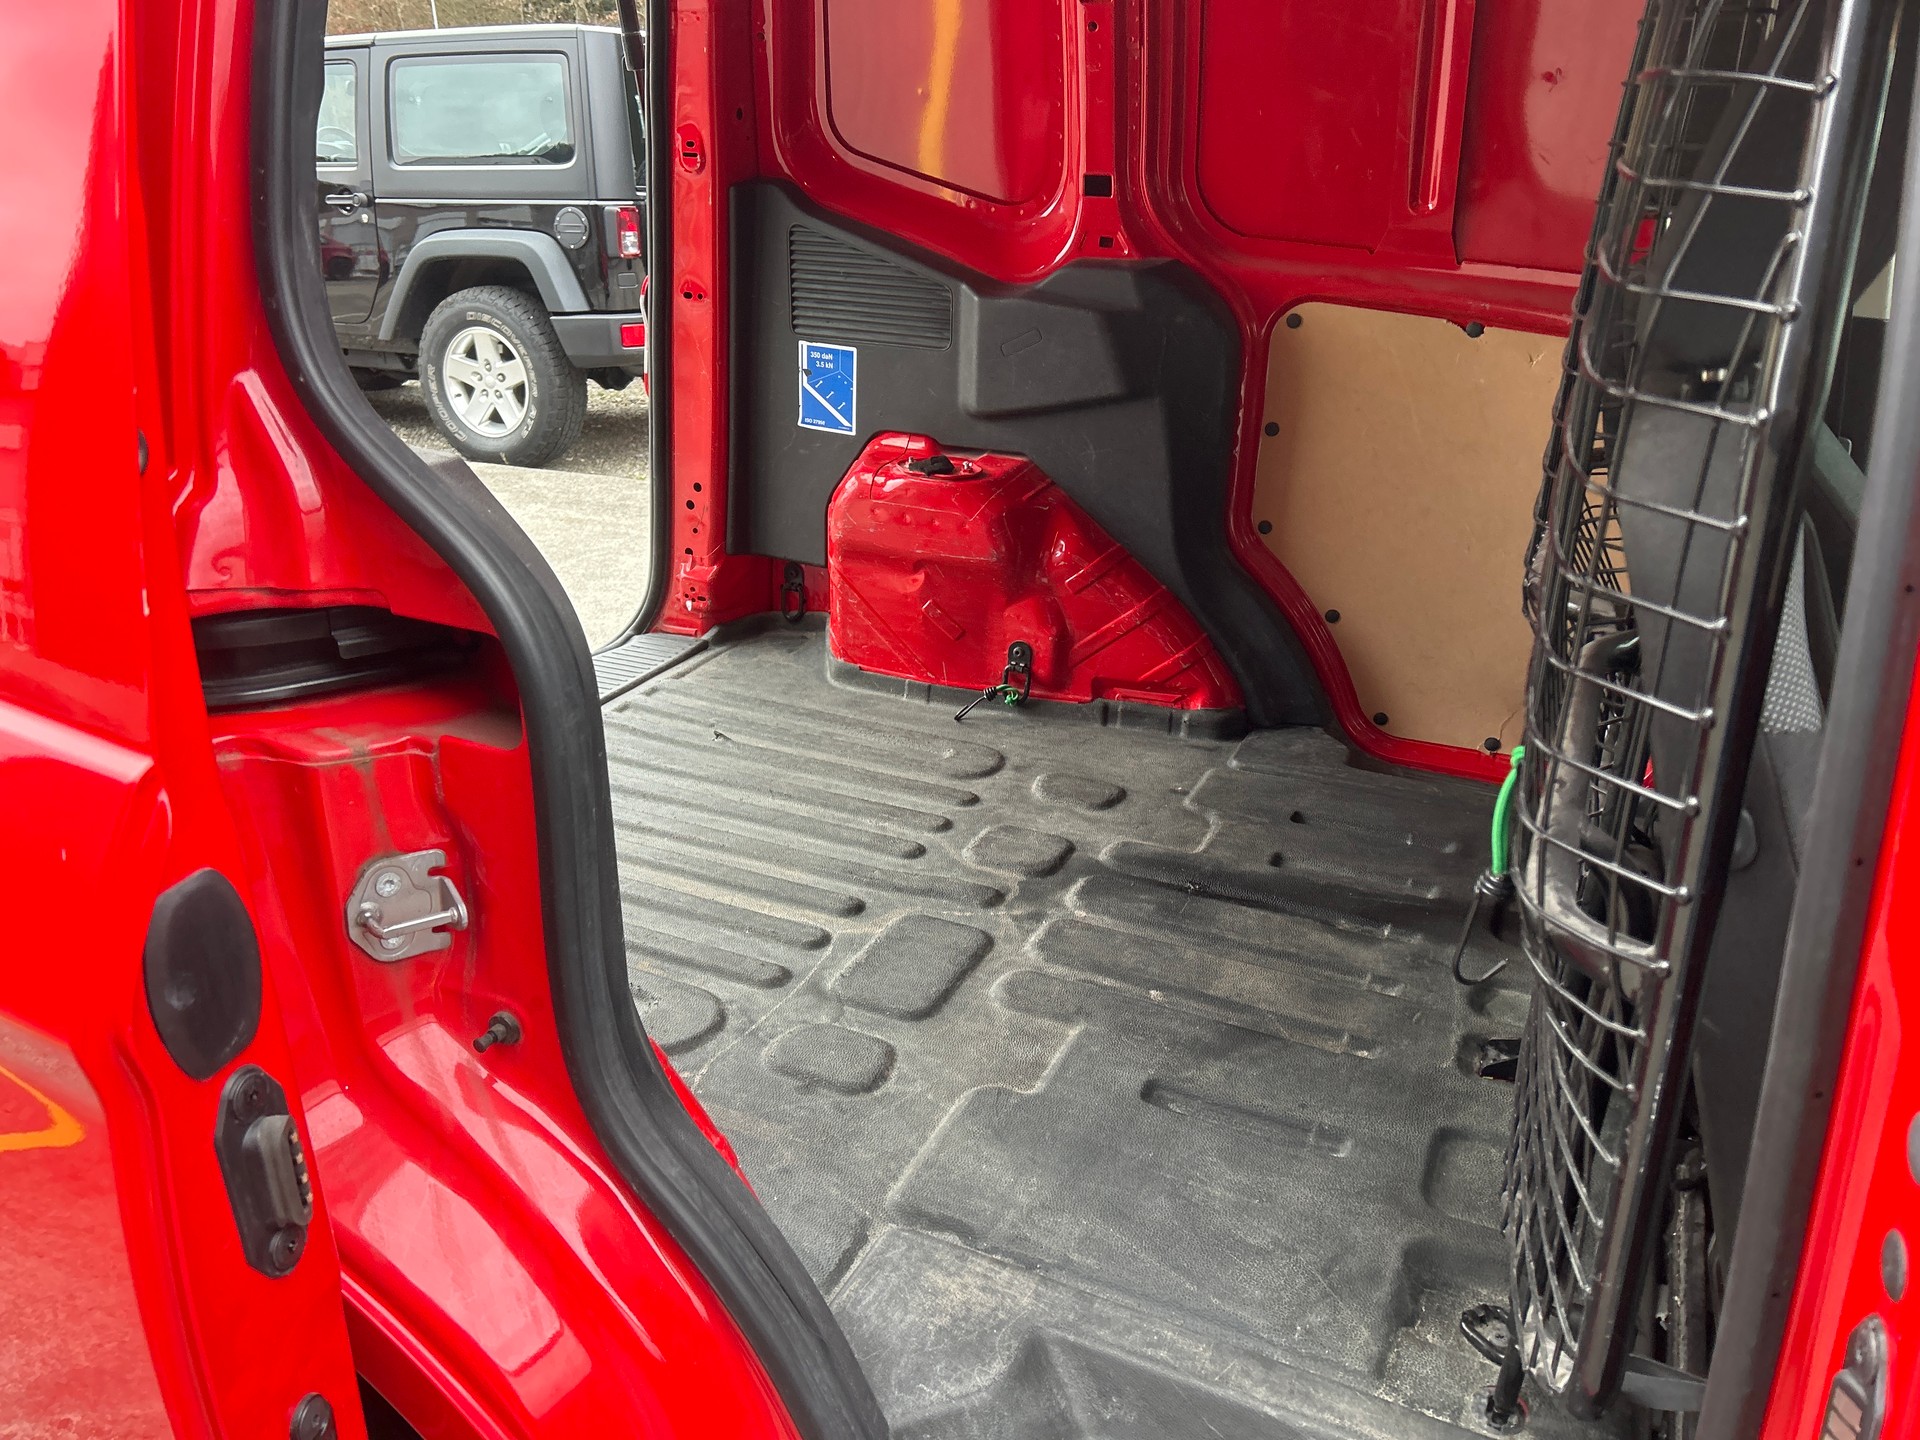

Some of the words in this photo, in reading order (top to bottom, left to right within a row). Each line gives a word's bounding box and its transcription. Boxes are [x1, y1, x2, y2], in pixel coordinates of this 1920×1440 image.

[466, 311, 538, 398] DISCOVERER
[810, 351, 821, 359] 350
[821, 352, 833, 361] daN
[815, 360, 825, 368] 3.5
[825, 361, 834, 369] kN
[426, 363, 468, 442] COOPER
